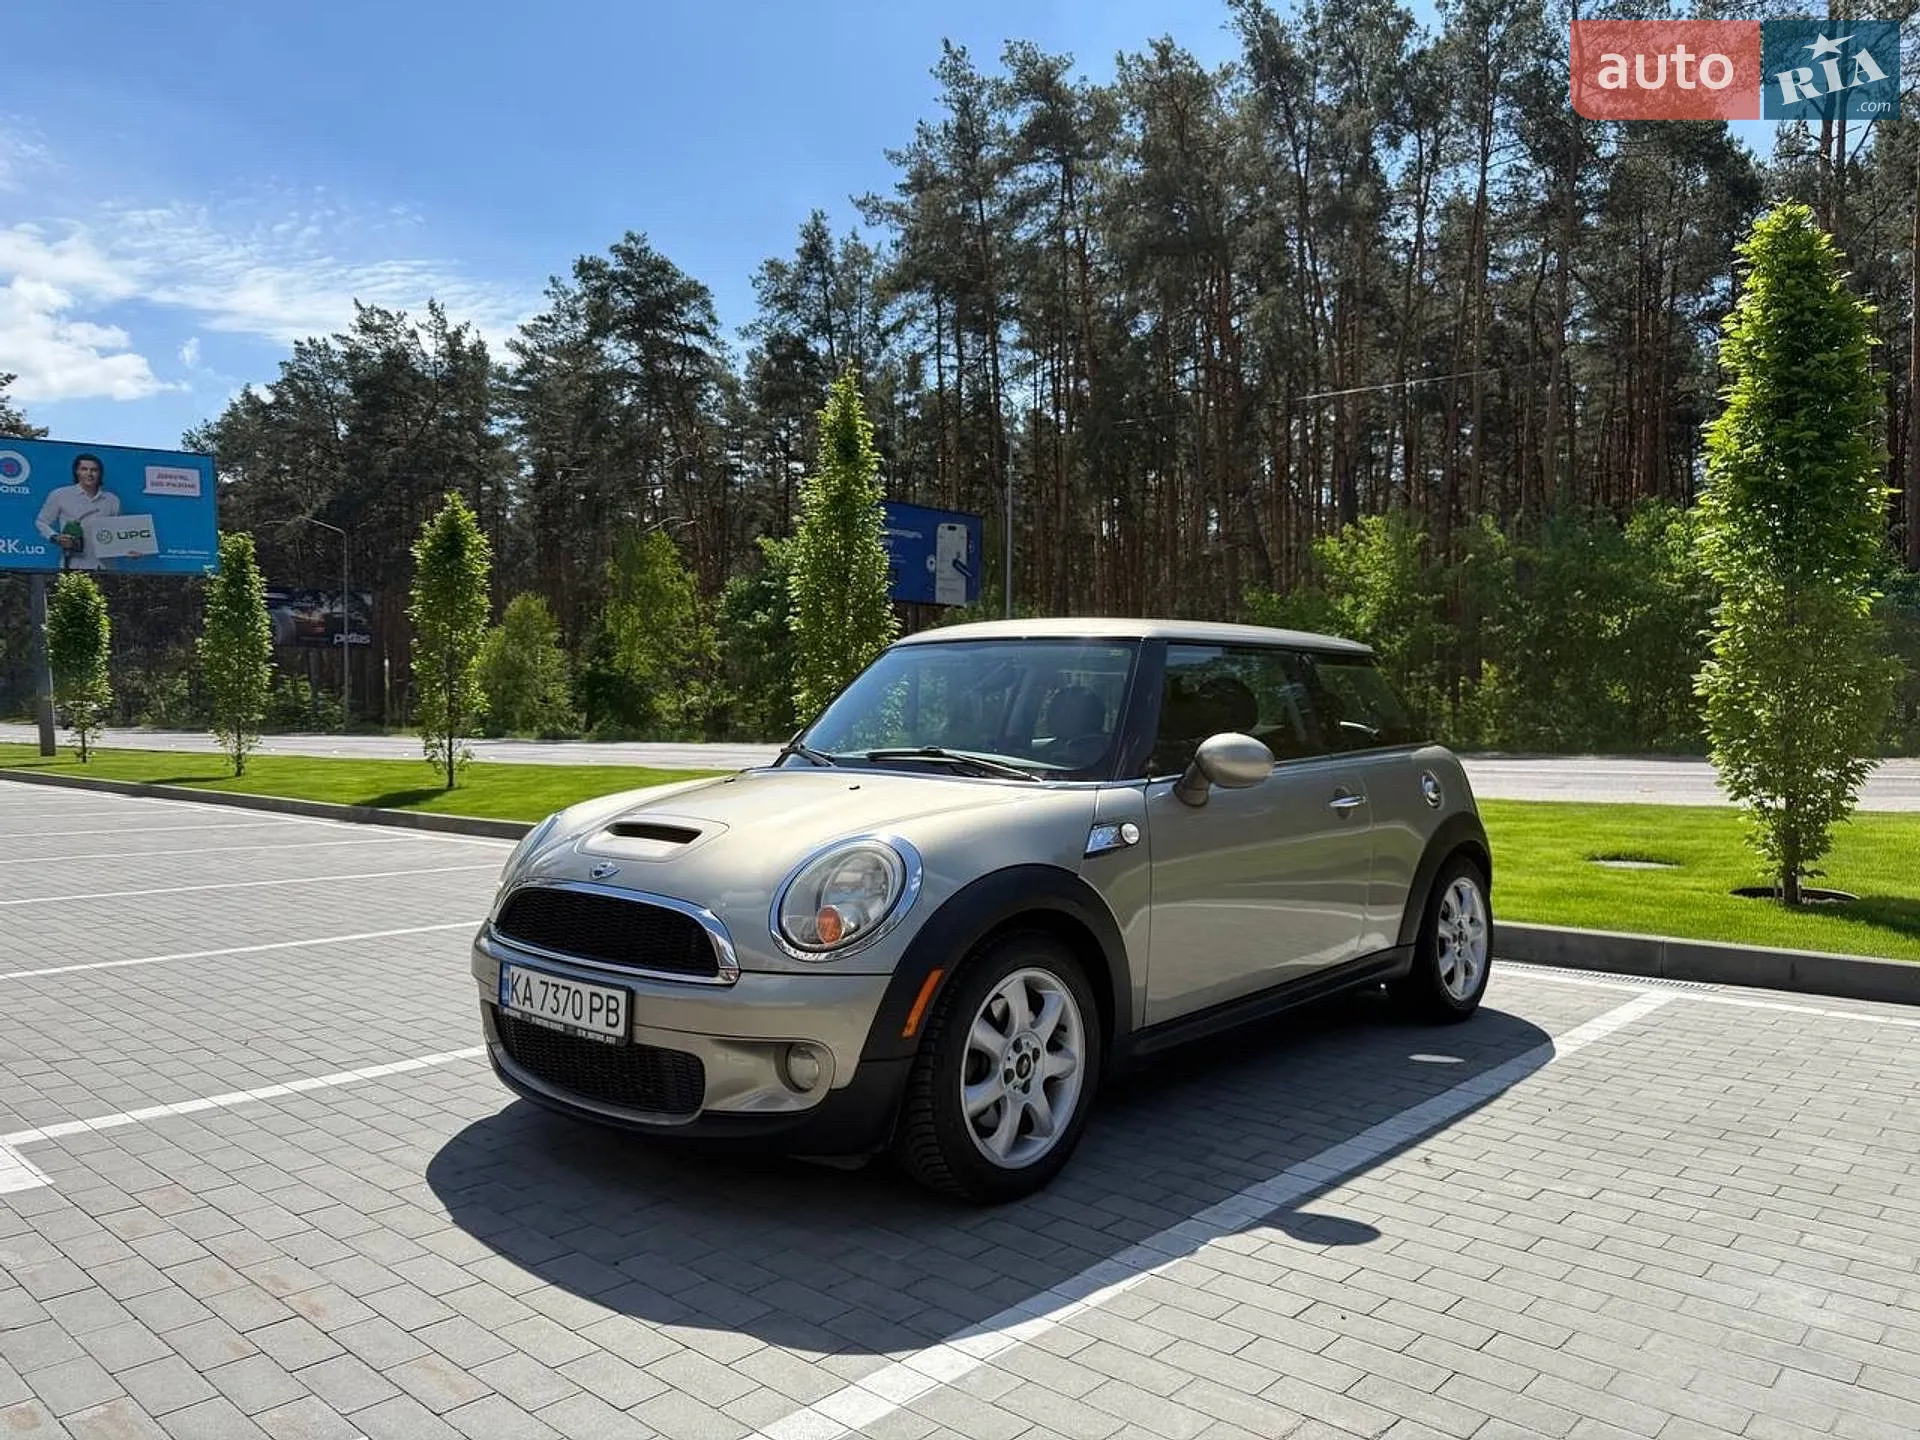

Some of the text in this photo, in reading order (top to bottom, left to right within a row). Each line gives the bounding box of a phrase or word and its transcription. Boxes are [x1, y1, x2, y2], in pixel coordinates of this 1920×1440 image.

[510, 972, 534, 1009] KA
[539, 980, 584, 1021] 7370
[589, 991, 620, 1028] PB
